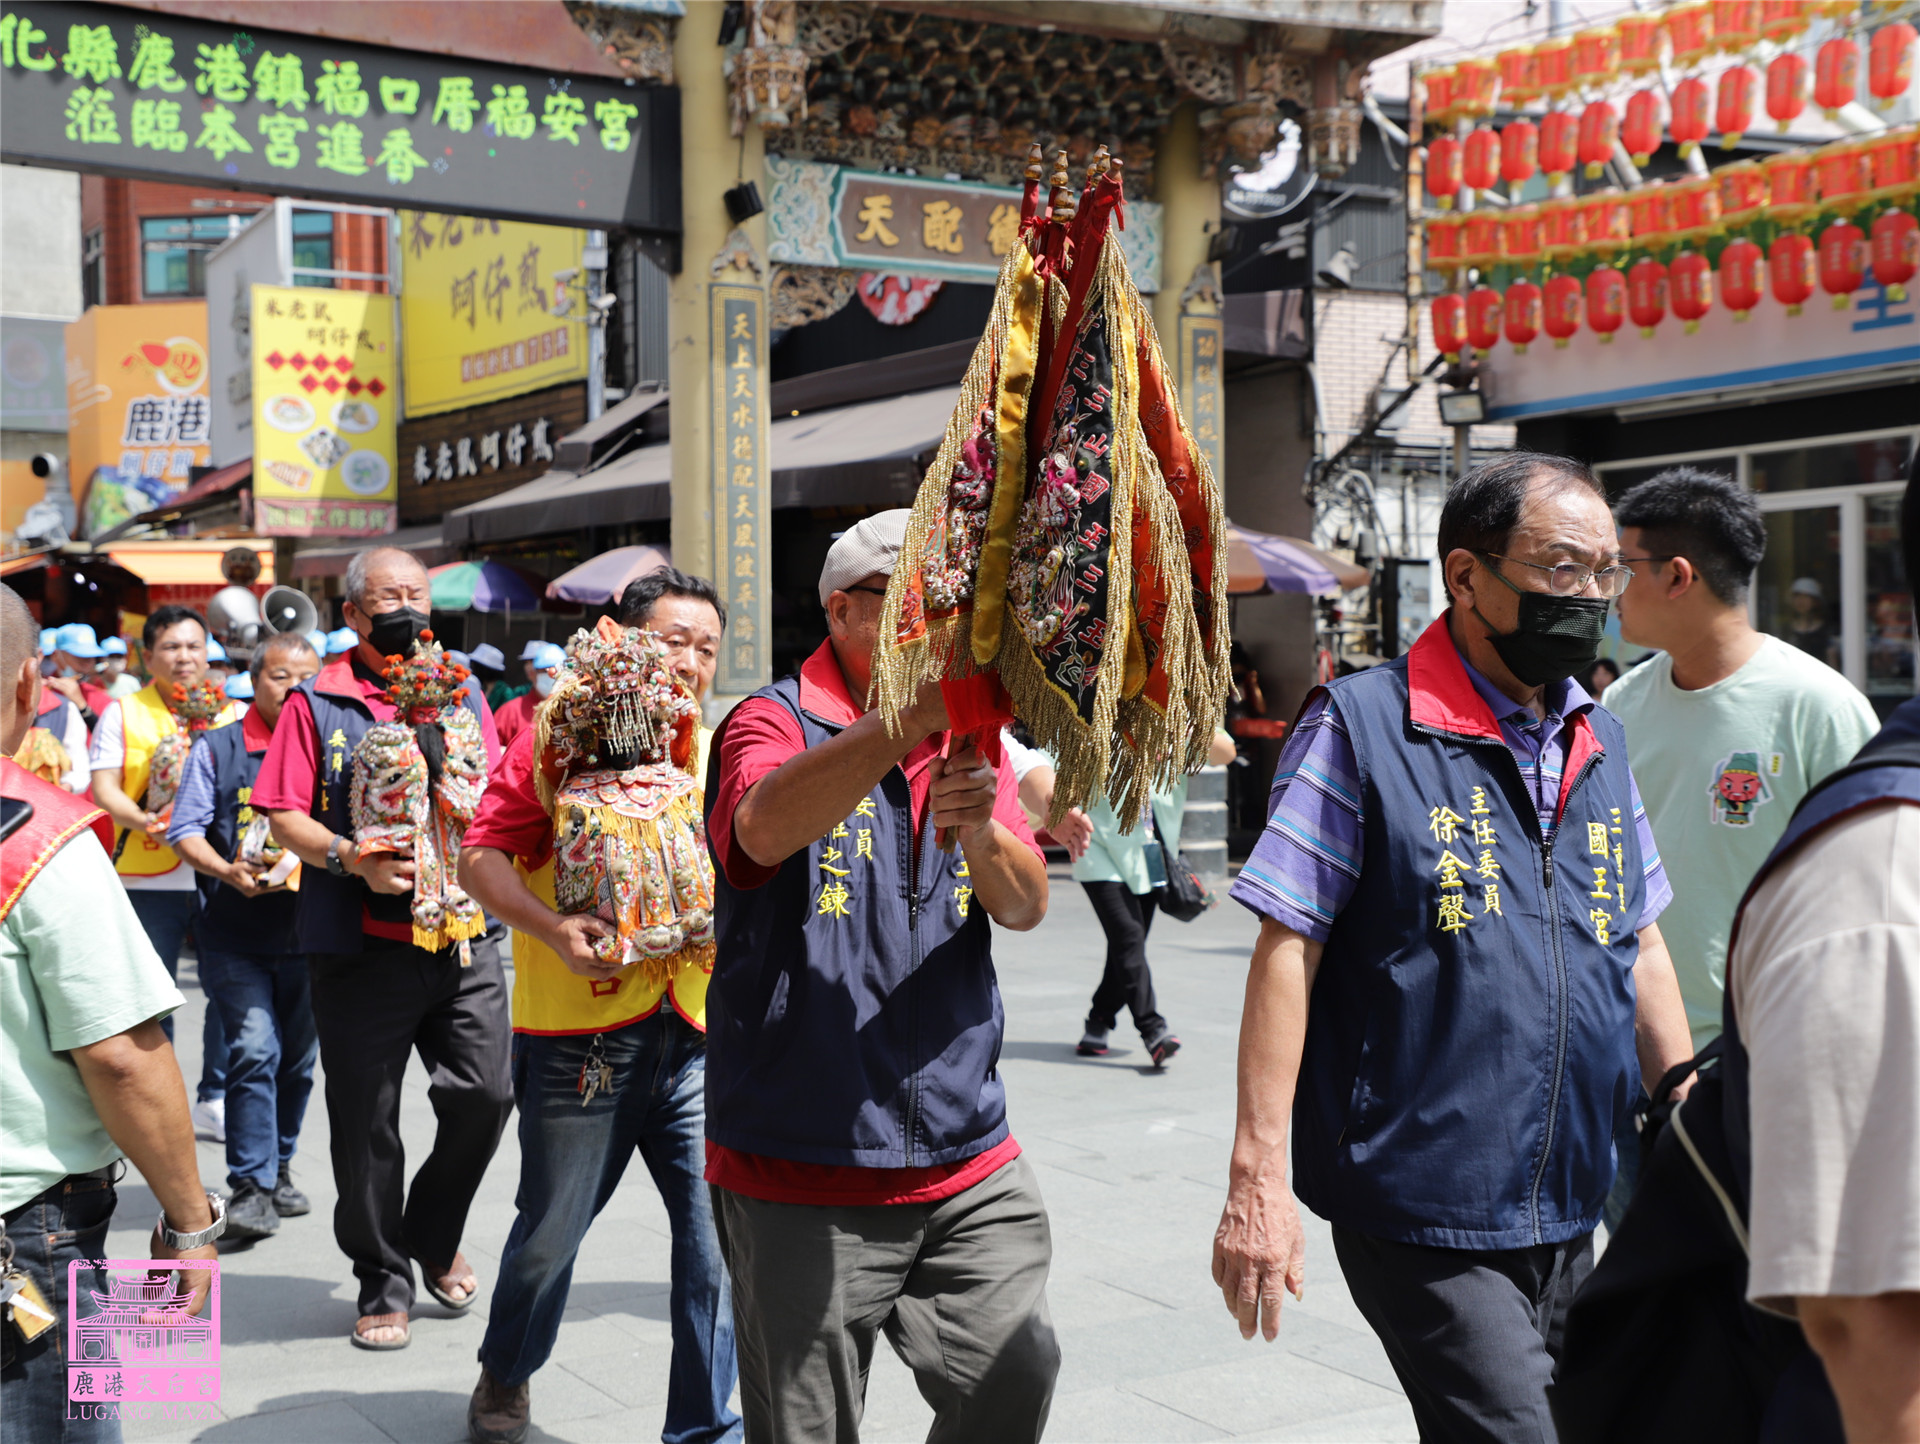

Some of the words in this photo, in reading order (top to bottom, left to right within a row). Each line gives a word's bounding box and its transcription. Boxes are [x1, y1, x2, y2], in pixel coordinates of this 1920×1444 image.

[64, 88, 429, 184] 蒞臨本宮進香
[123, 396, 206, 443] 鹿港
[1429, 806, 1475, 935] 徐金聲
[1470, 786, 1503, 917] 主任委員
[1587, 821, 1612, 946] 國王宮
